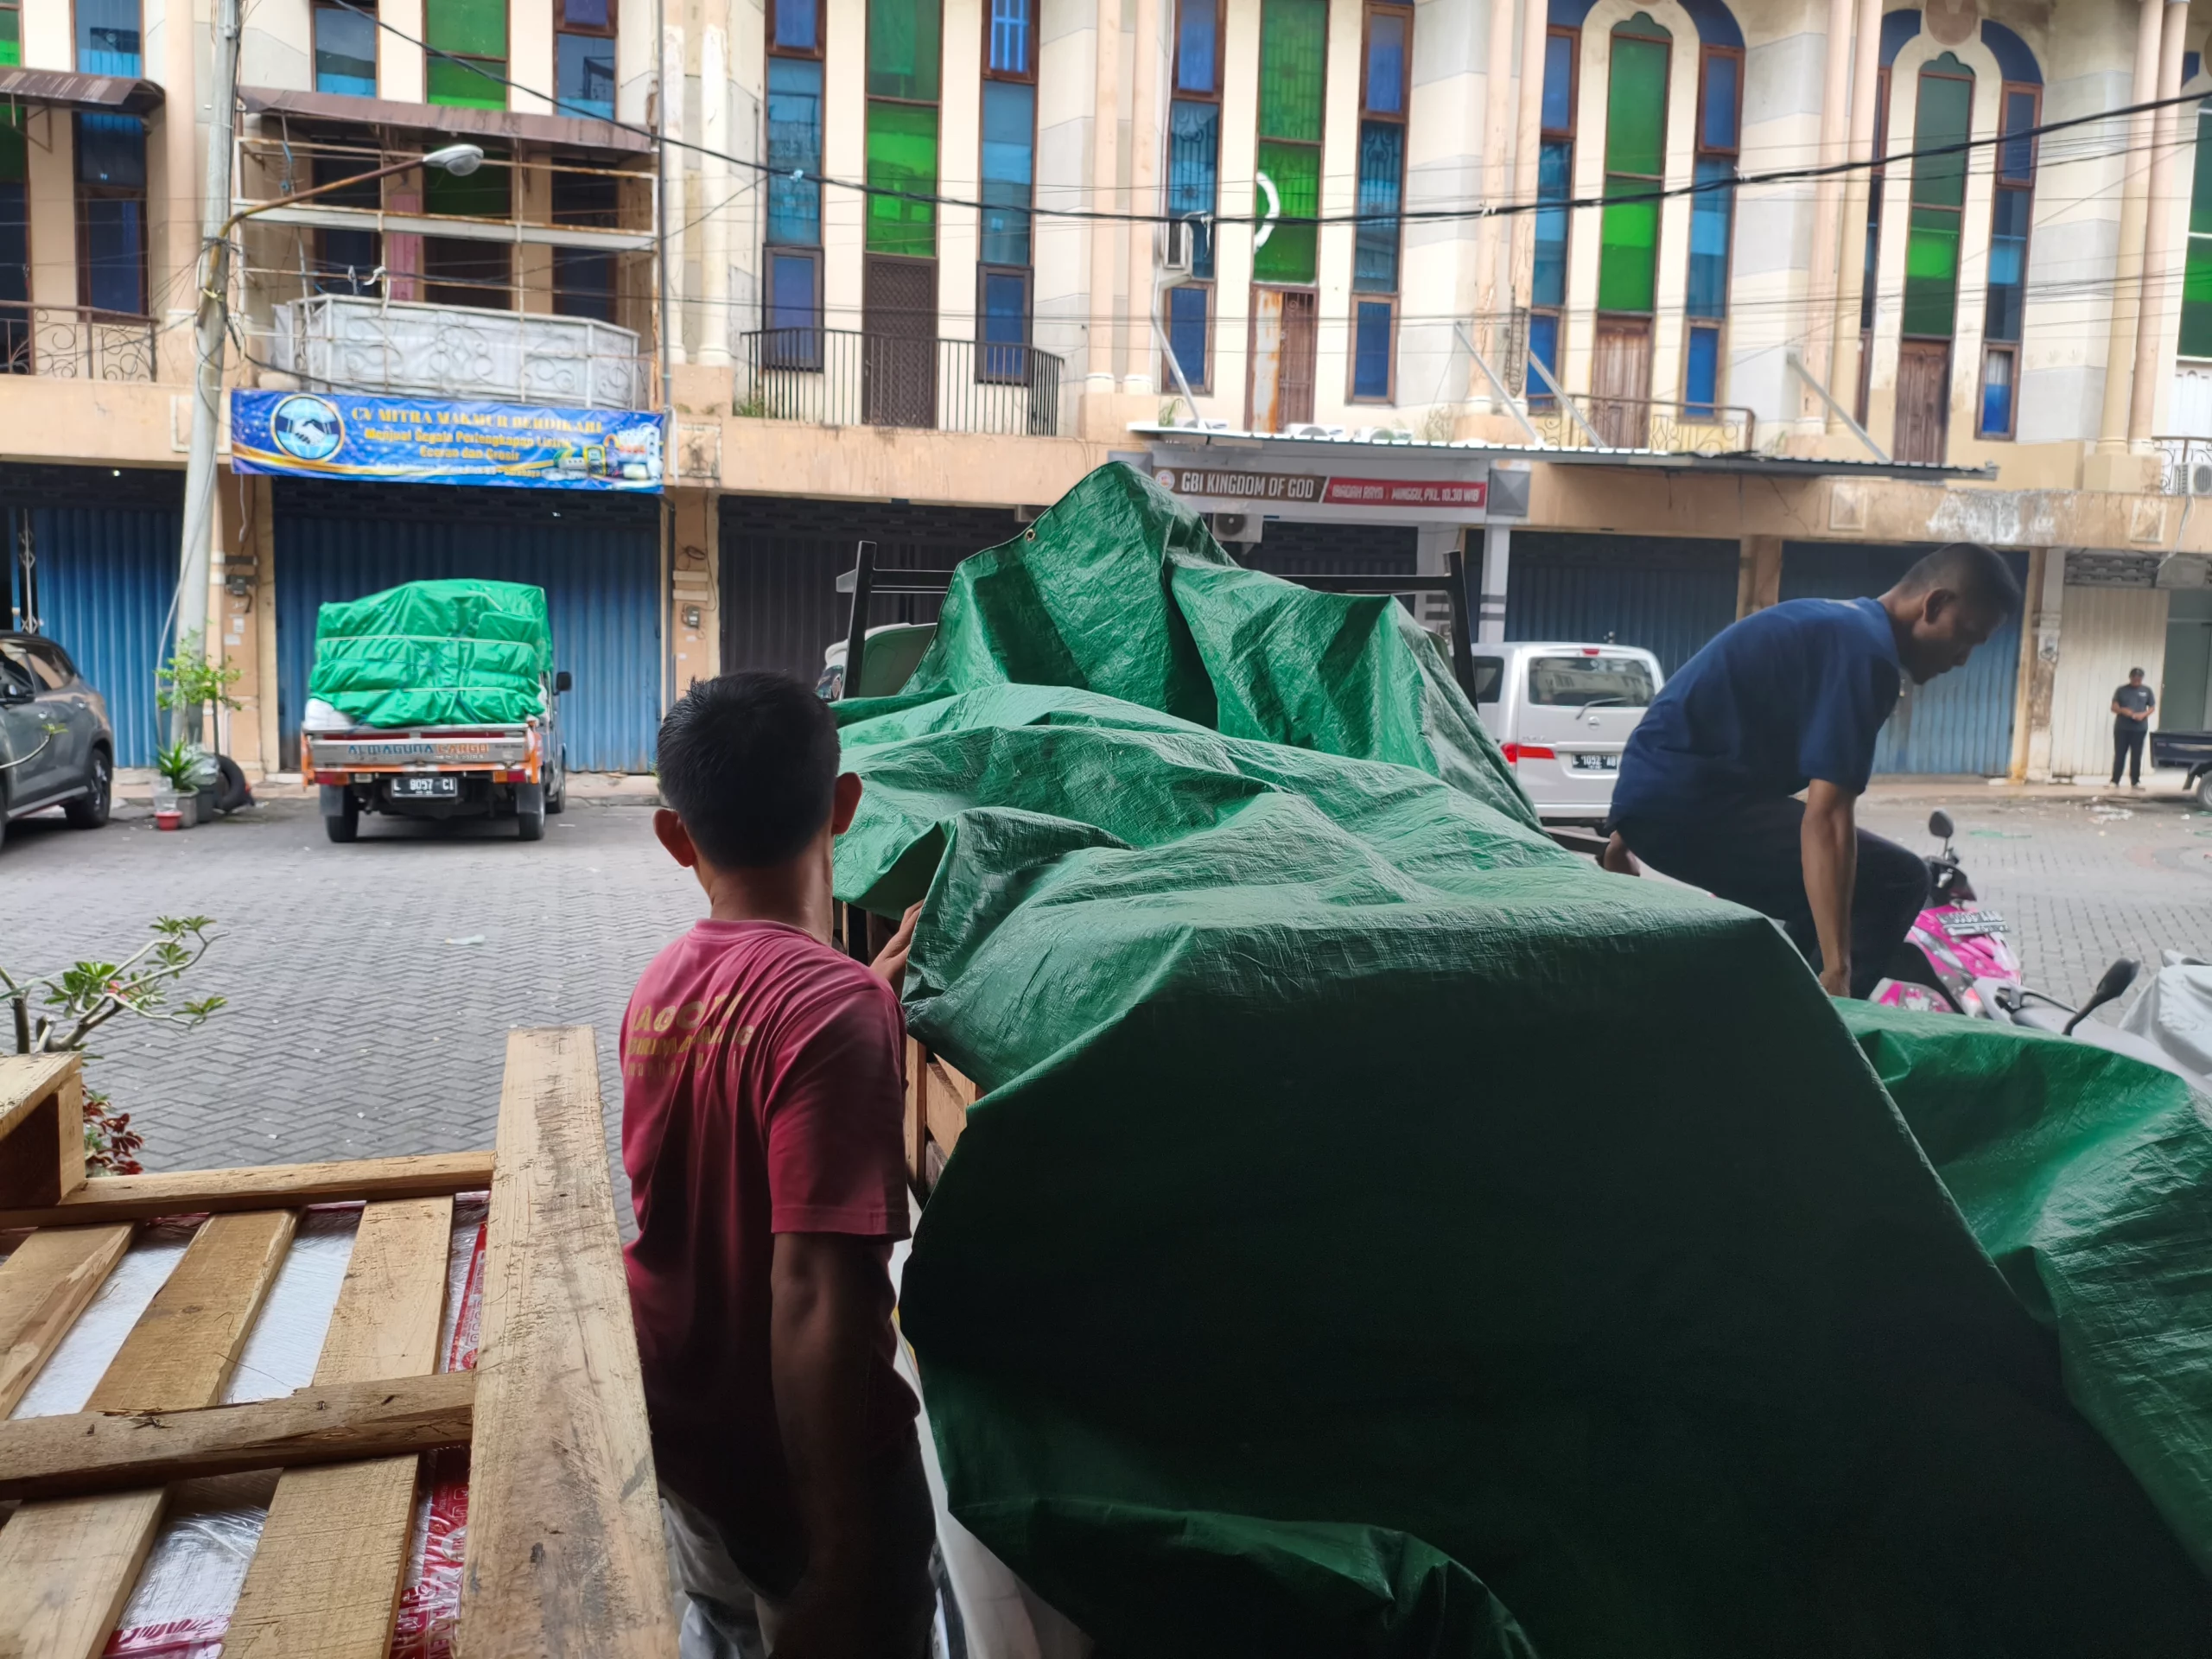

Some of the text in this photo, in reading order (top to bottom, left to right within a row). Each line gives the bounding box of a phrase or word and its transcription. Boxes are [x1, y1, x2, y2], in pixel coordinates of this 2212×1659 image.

[352, 407, 372, 421] CV
[378, 409, 433, 423] MITRA
[436, 411, 508, 428] MAKMUR
[461, 448, 483, 459] dan
[1181, 472, 1314, 499] GBI KINGDOM OF GOD
[1332, 484, 1362, 499] IBADAH
[1463, 488, 1481, 503] WIB
[436, 743, 490, 754] CARGO
[393, 779, 401, 791] L
